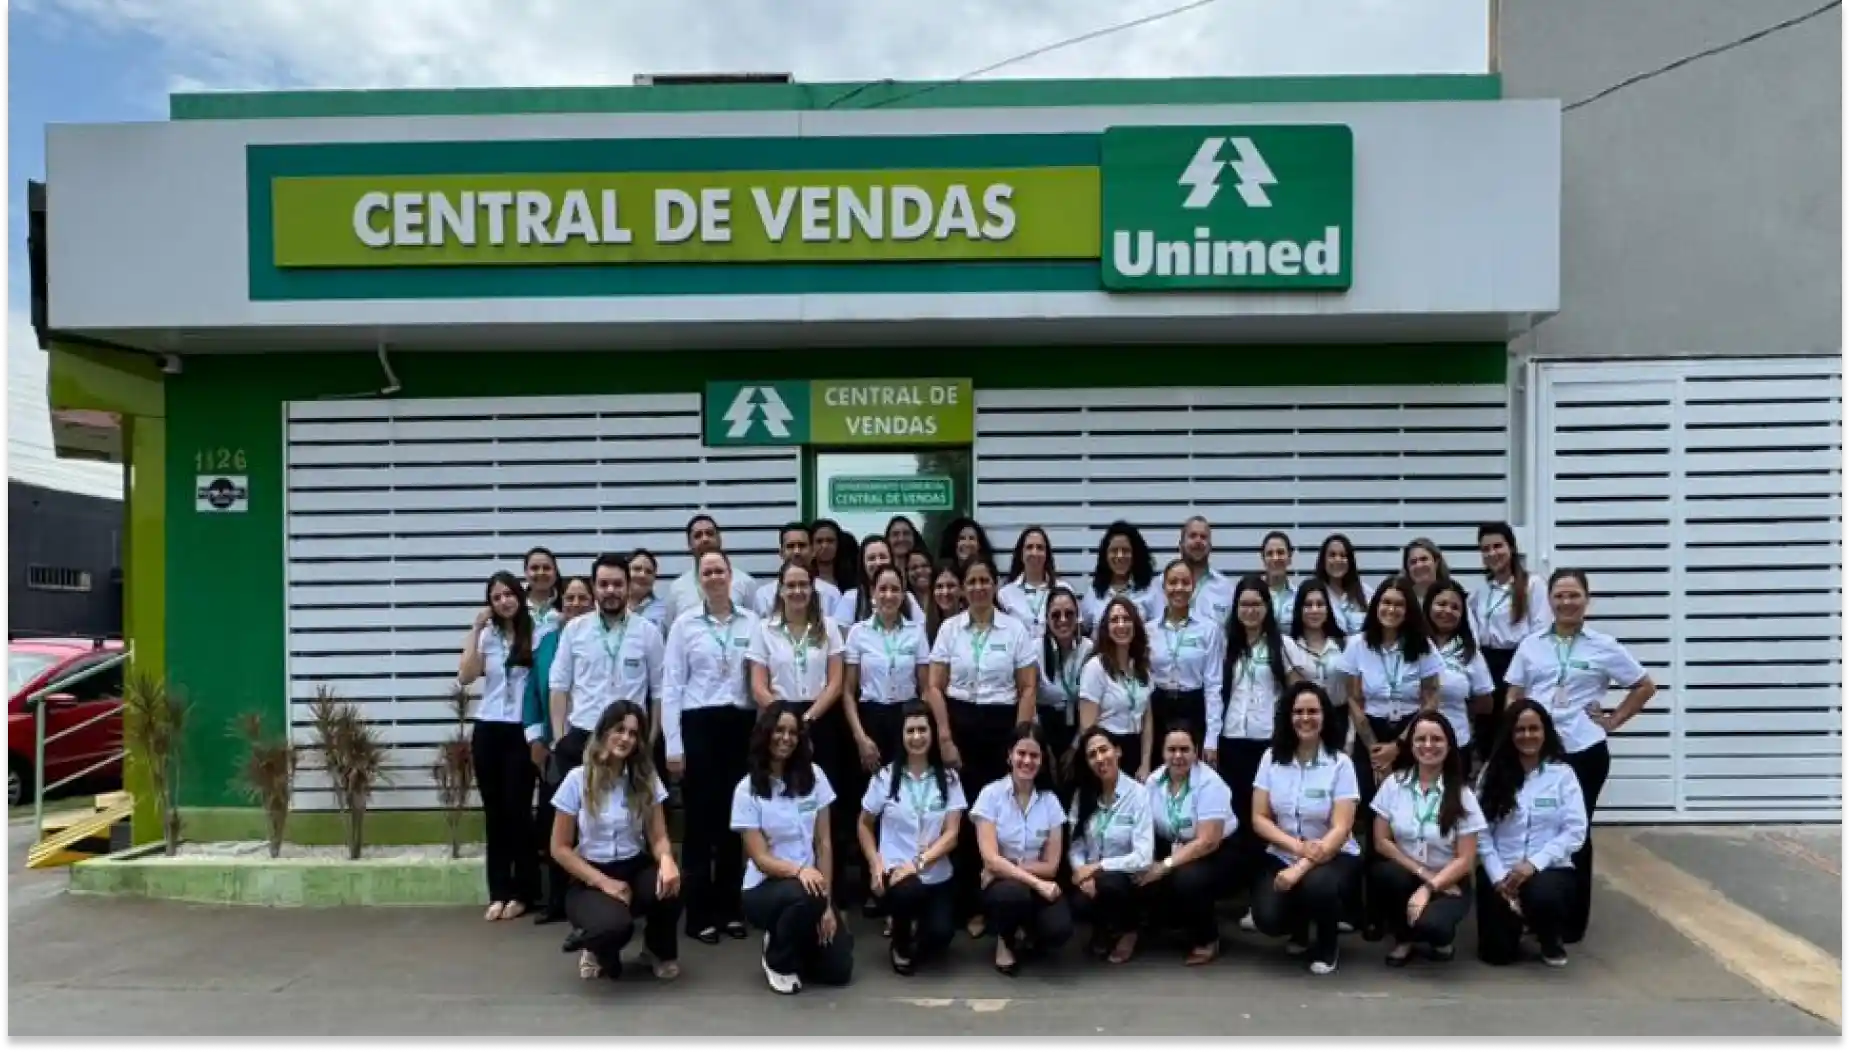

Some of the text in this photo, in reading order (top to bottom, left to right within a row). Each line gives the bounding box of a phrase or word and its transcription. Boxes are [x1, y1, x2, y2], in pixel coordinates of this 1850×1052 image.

[353, 183, 1016, 247] CENTRAL DE VENDAS
[1113, 225, 1340, 277] Unimed
[824, 385, 958, 406] CENTRAL DE
[845, 415, 938, 436] VENDAS
